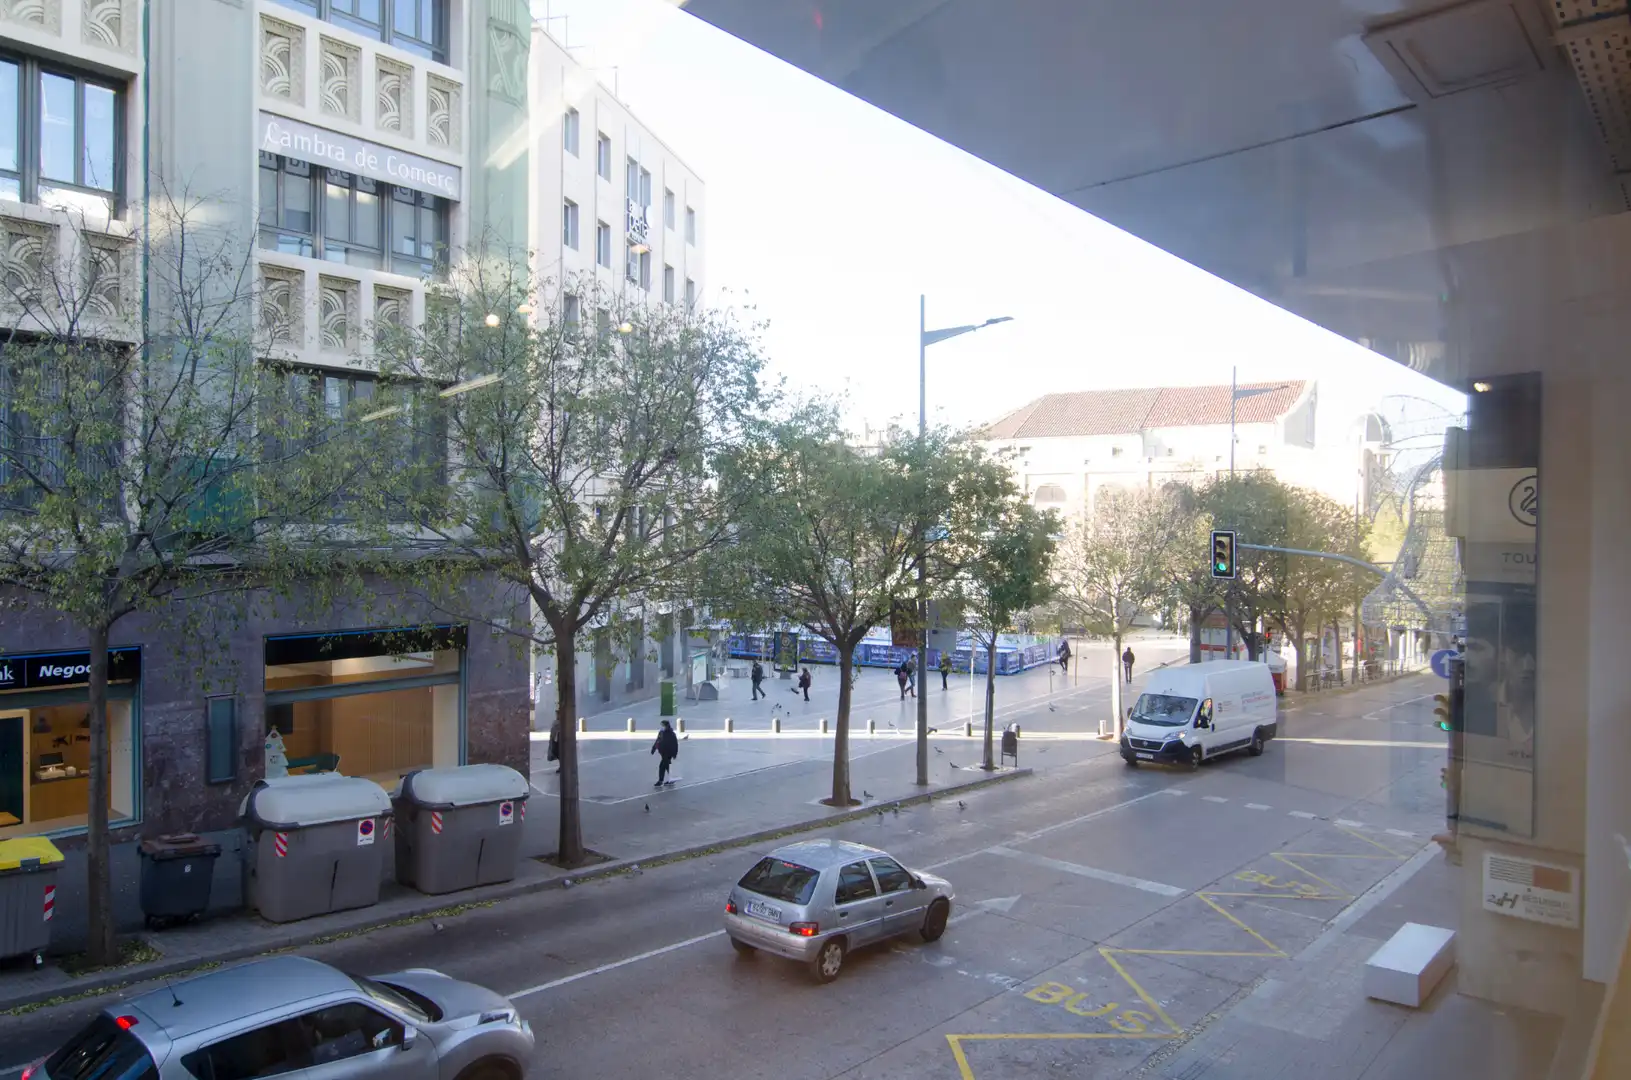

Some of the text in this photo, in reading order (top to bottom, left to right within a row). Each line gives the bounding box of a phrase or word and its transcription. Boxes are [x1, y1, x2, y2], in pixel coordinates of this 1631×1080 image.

[264, 118, 345, 161] Cambra
[355, 147, 378, 171] de
[387, 155, 454, 195] Comerç
[1022, 981, 1155, 1033] BUS
